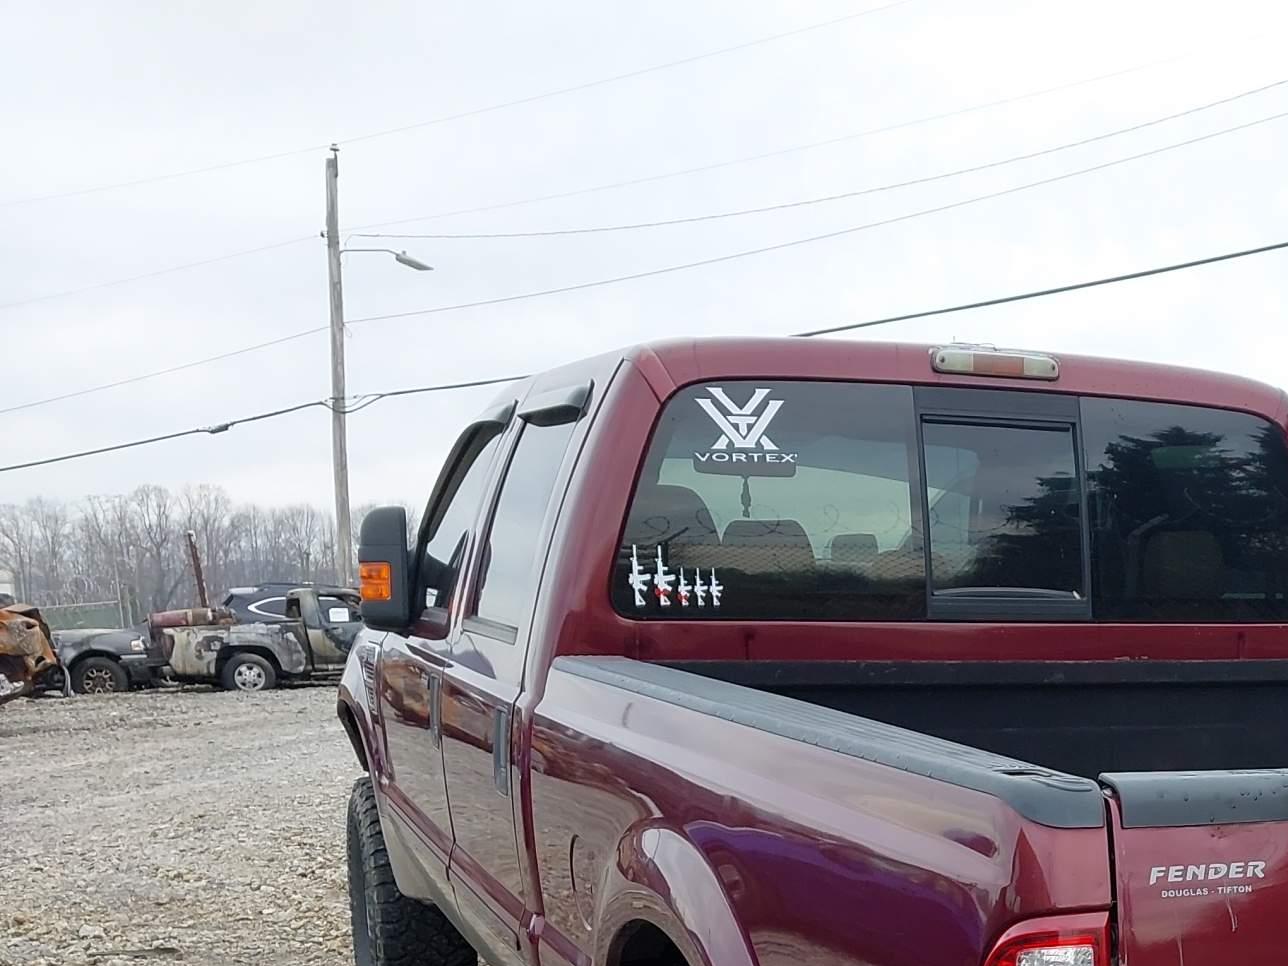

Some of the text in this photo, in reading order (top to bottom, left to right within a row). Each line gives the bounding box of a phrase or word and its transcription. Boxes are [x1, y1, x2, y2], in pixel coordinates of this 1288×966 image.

[694, 452, 796, 463] VORTEX
[1149, 861, 1266, 886] FENDER
[1161, 887, 1209, 898] DOUGLAS
[1217, 885, 1252, 895] TIFTON
